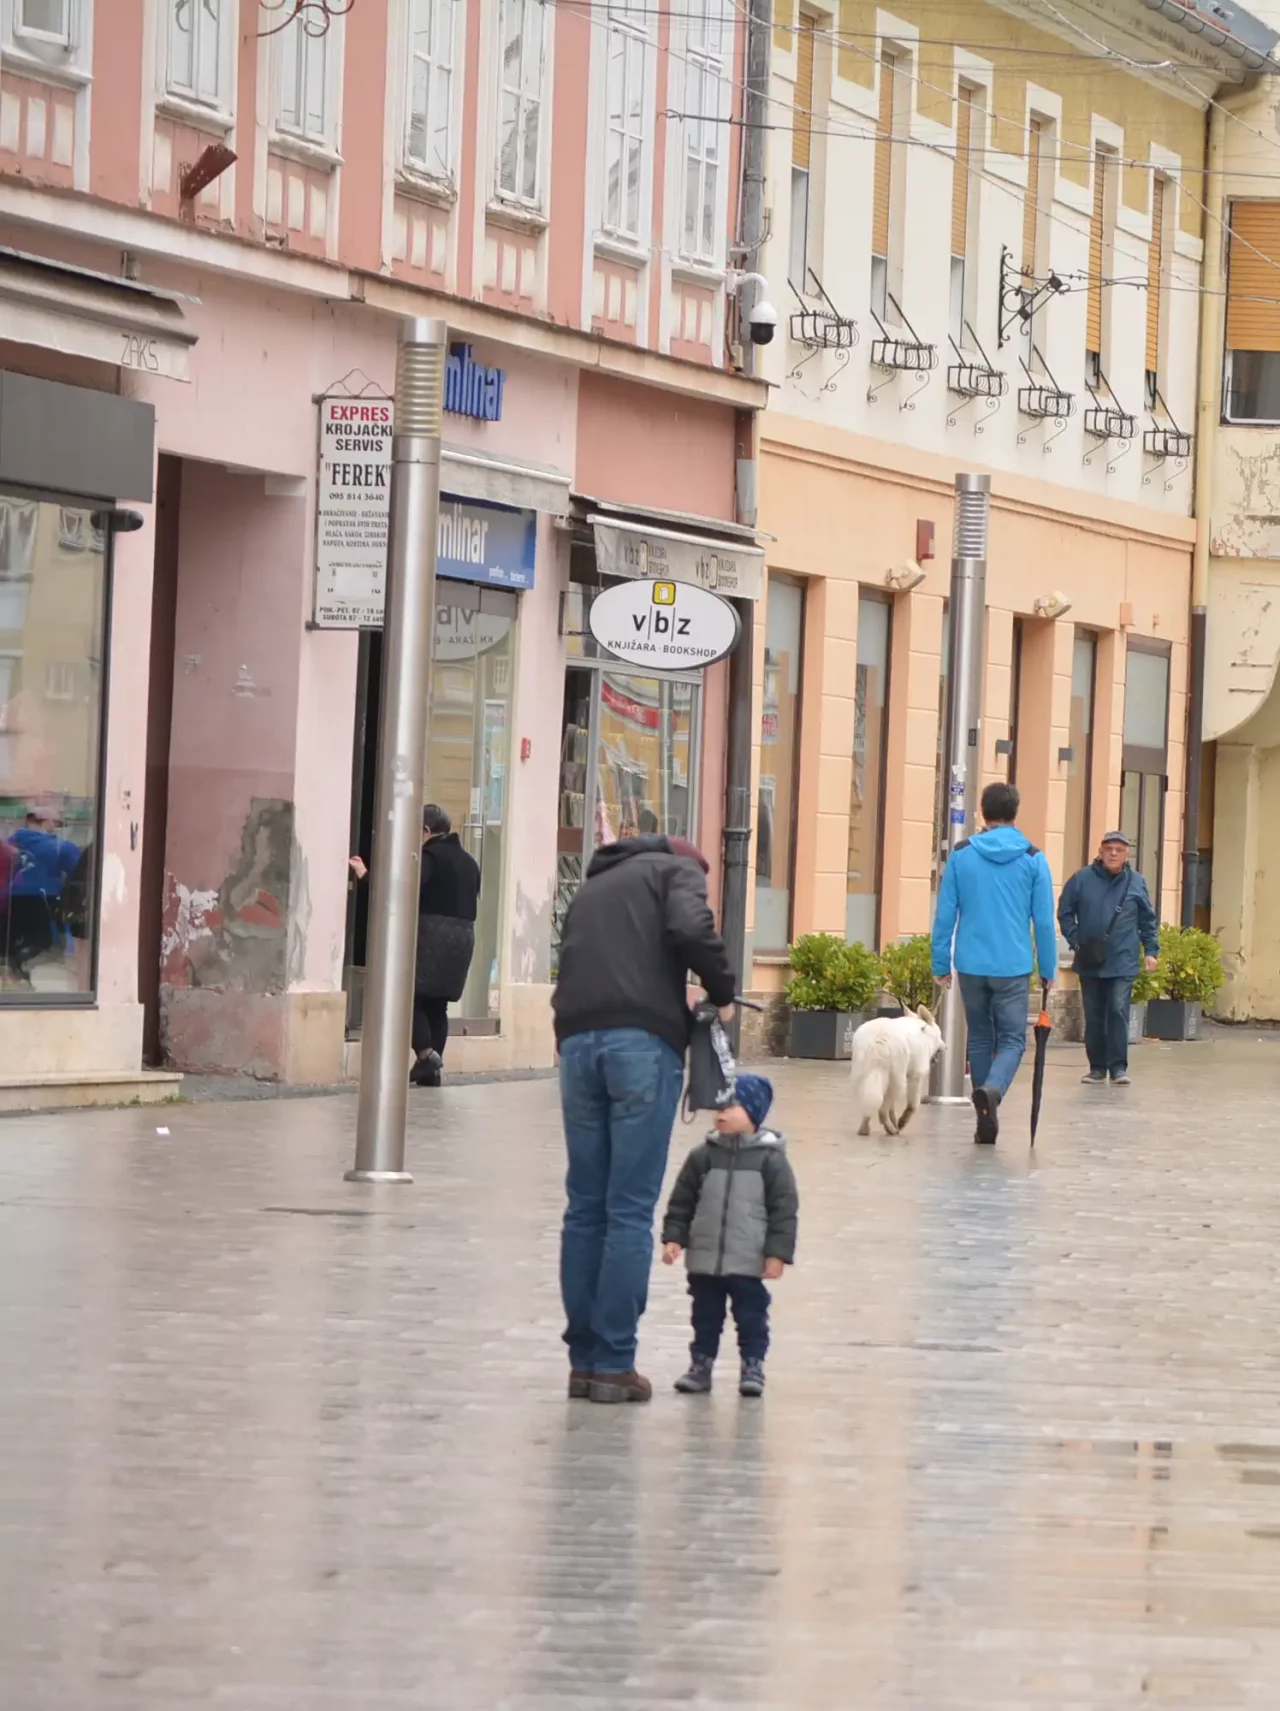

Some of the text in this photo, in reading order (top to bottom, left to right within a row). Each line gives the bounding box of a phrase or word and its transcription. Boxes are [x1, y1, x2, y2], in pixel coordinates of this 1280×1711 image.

[121, 334, 158, 371] ZAKS
[443, 343, 506, 421] mlinar
[330, 405, 389, 422] EXPRES
[325, 420, 392, 437] KROJAČKI
[335, 439, 383, 452] SERVIS
[437, 503, 489, 565] mlinar
[607, 640, 717, 658] KNJIŽARA BOOKSHOP
